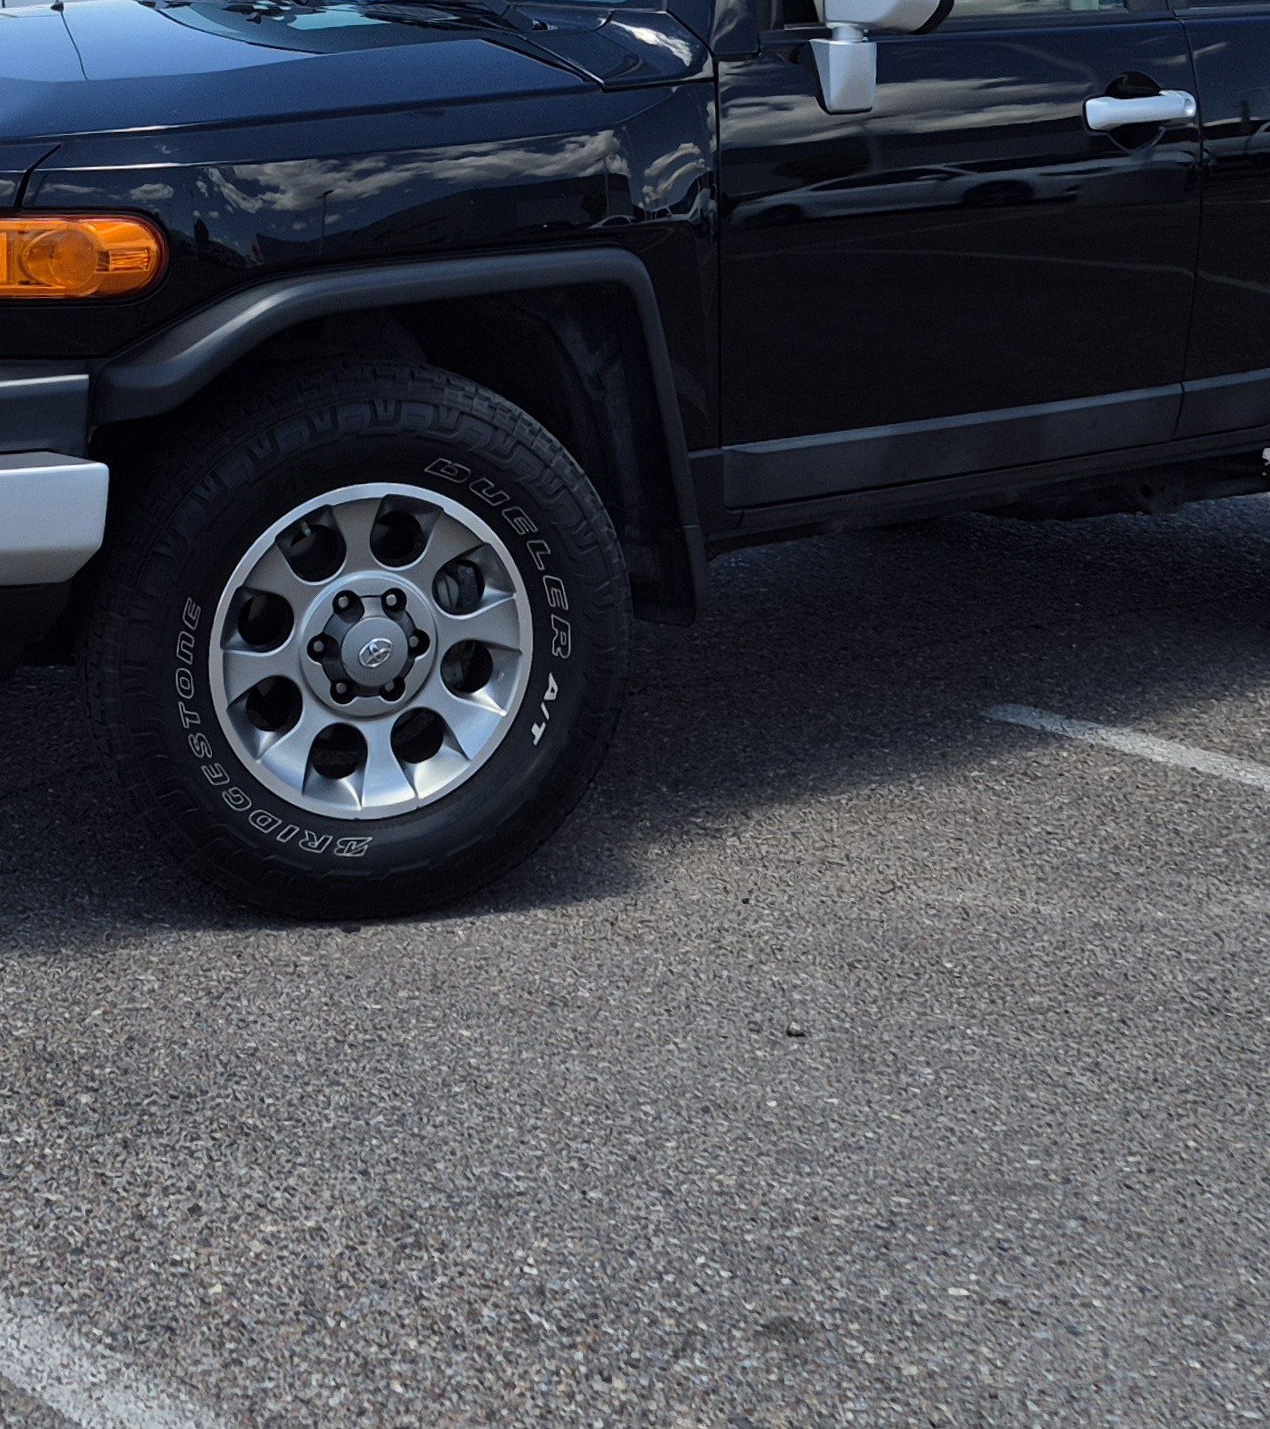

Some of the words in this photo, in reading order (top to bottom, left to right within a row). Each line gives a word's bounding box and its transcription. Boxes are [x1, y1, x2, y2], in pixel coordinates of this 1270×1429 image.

[175, 597, 373, 857] BRIDGESTONE
[424, 458, 572, 659] DUELER
[531, 672, 559, 746] A/T
